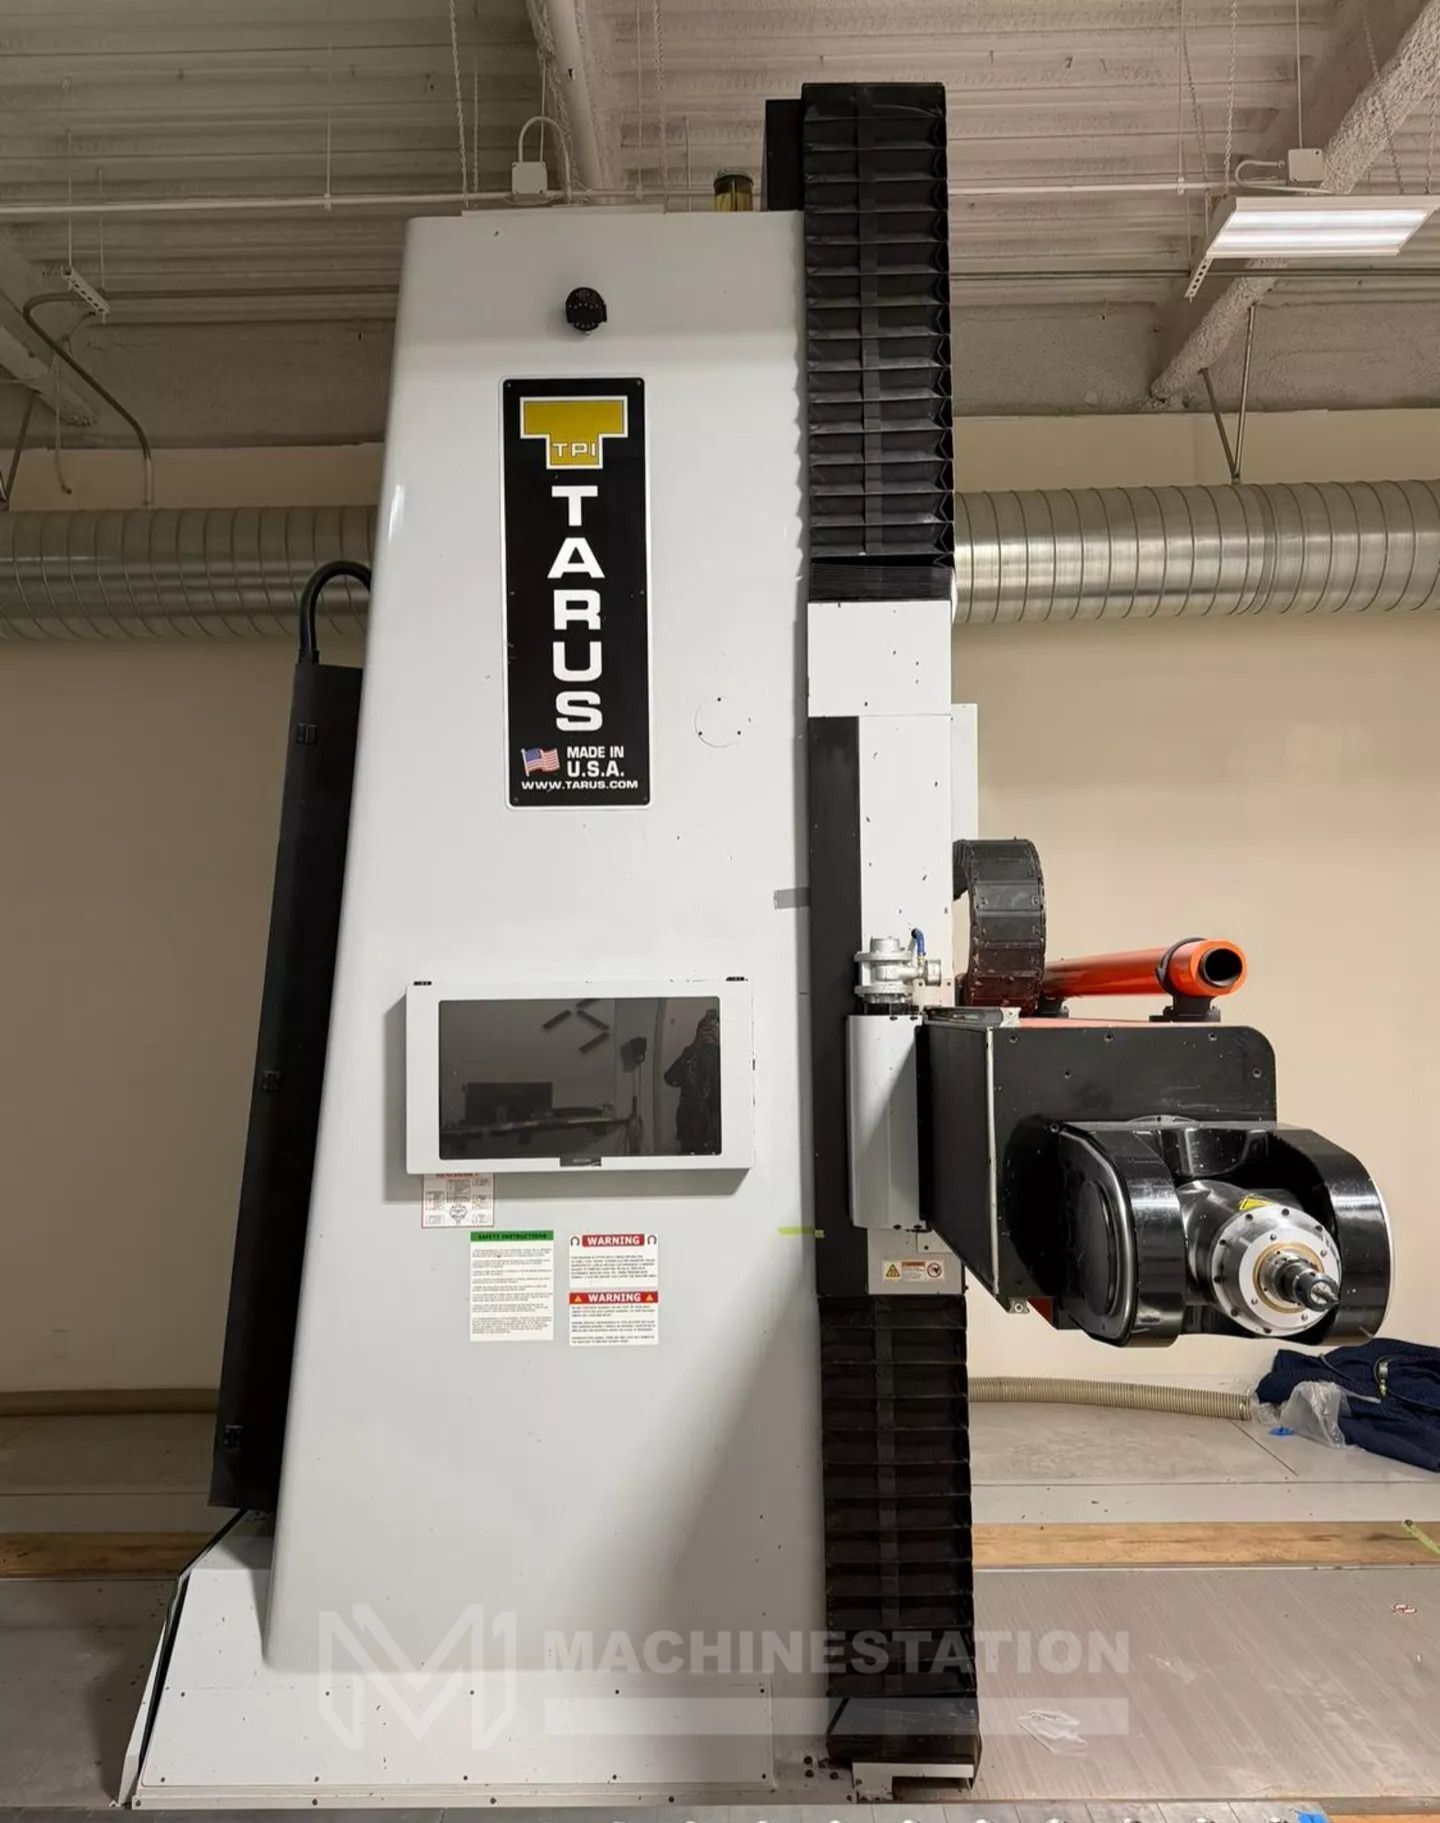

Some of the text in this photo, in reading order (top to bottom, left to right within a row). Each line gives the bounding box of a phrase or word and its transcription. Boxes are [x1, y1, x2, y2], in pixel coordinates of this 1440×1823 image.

[552, 442, 596, 457] TPI
[547, 485, 606, 732] TARUS
[566, 746, 625, 759] MADE IN
[567, 760, 625, 777] U.S.A.
[521, 780, 639, 790] WWW.TARUS.COM
[587, 1235, 641, 1246] WARNING
[588, 1293, 641, 1303] WARNING
